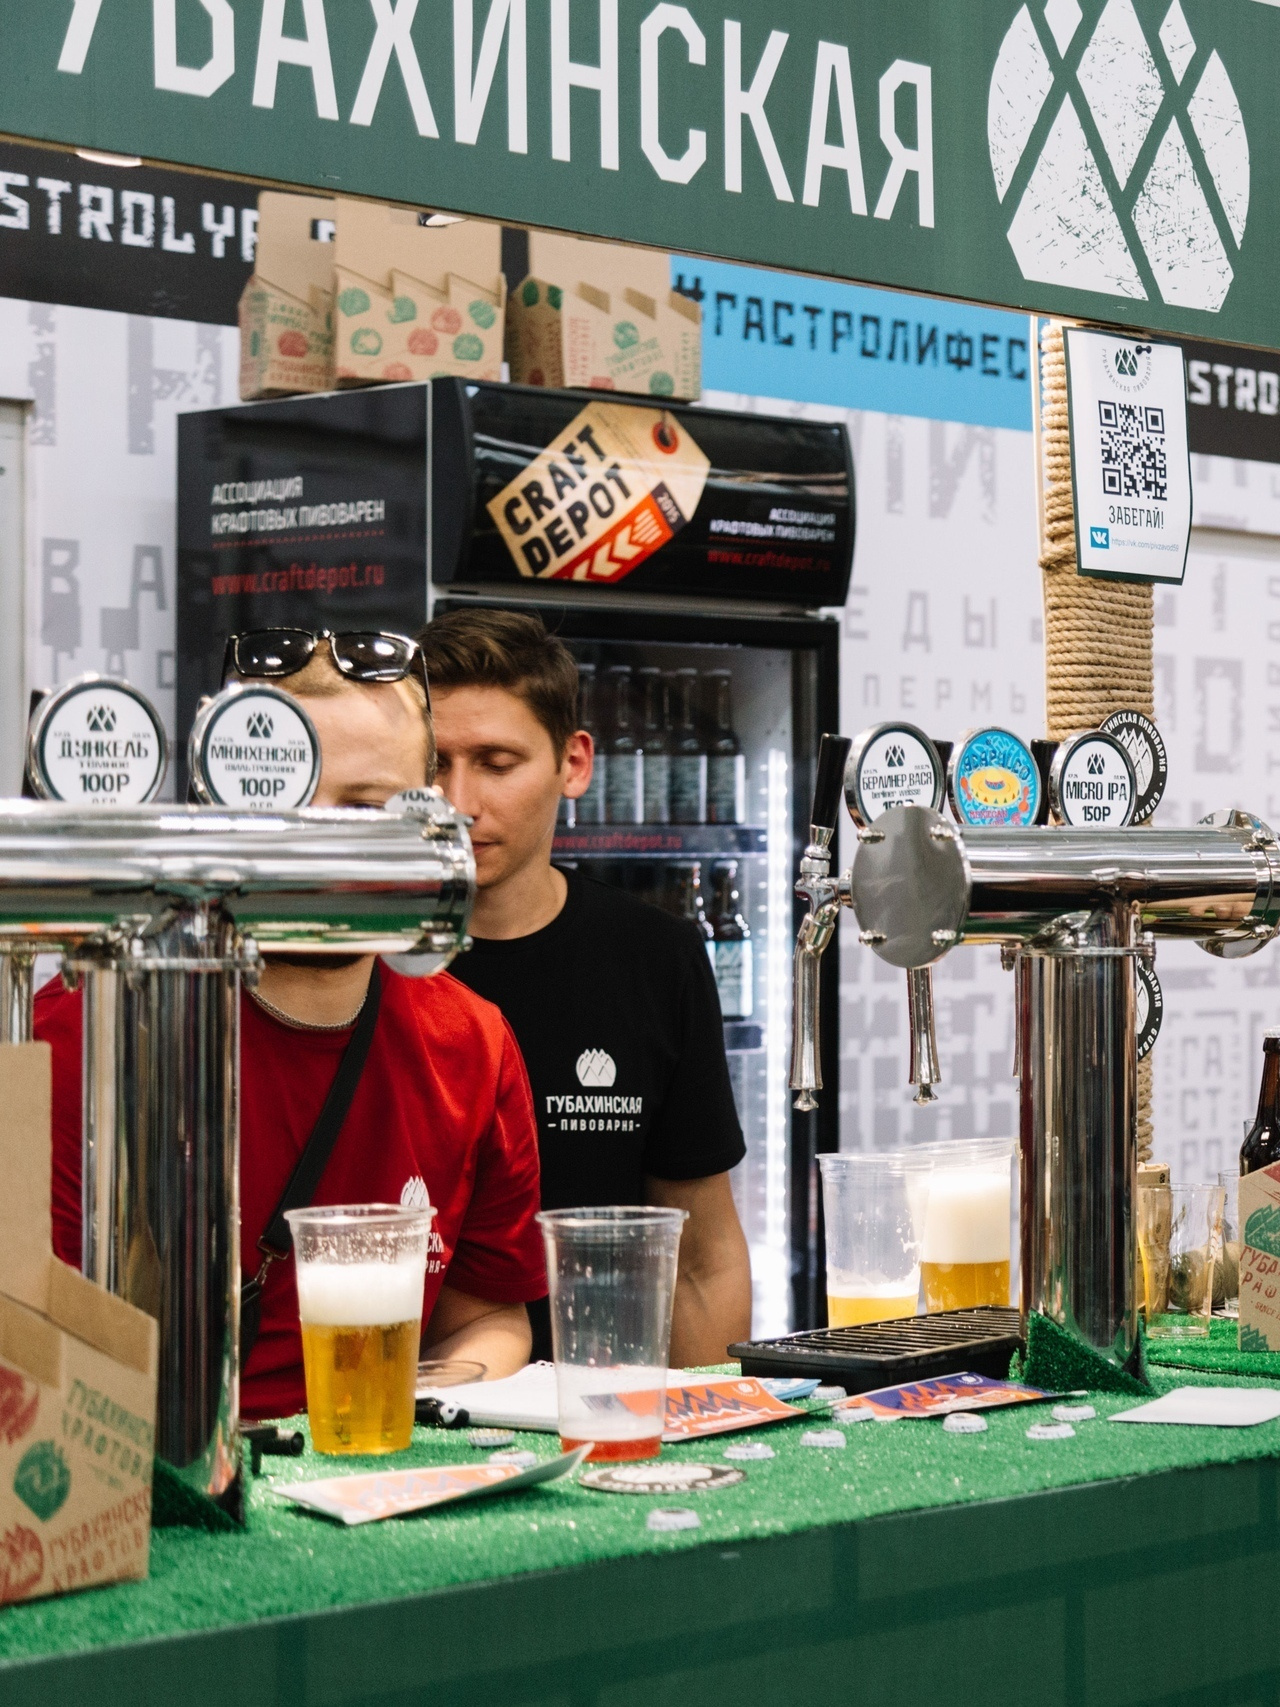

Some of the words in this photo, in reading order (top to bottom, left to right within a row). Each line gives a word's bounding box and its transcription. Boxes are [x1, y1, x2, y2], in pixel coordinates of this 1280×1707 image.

[56, 0, 936, 229] БАХИНСКАЯ
[672, 272, 1028, 384] #ГАСТРОЛИФЕС
[211, 475, 304, 506] АССОЦИАЦИЯ
[503, 424, 607, 537] CRAFT
[300, 499, 386, 528] ПИВОВАРЕН
[520, 463, 632, 576] DEPOT
[1108, 505, 1165, 530] ЗАБЕГАЙ!
[211, 562, 385, 596] www.craftdepot.ru
[58, 740, 148, 759] ДУНКЕЛЬ
[210, 744, 310, 763] МЮНХЕНСКОЕ
[1103, 712, 1138, 734] ХИНСКАЯ
[1137, 716, 1167, 772] ПИВОВАРНЯ
[79, 773, 130, 793] 100Р
[239, 777, 286, 797] 100Р
[862, 773, 907, 791] БЕРЛИНЕР
[908, 771, 933, 787] ВАСЯ
[1065, 781, 1103, 801] MICRO
[1107, 782, 1128, 801] IPA
[1081, 805, 1111, 822] 150Р
[545, 1095, 643, 1114] ГУБАХИНСКАЯ
